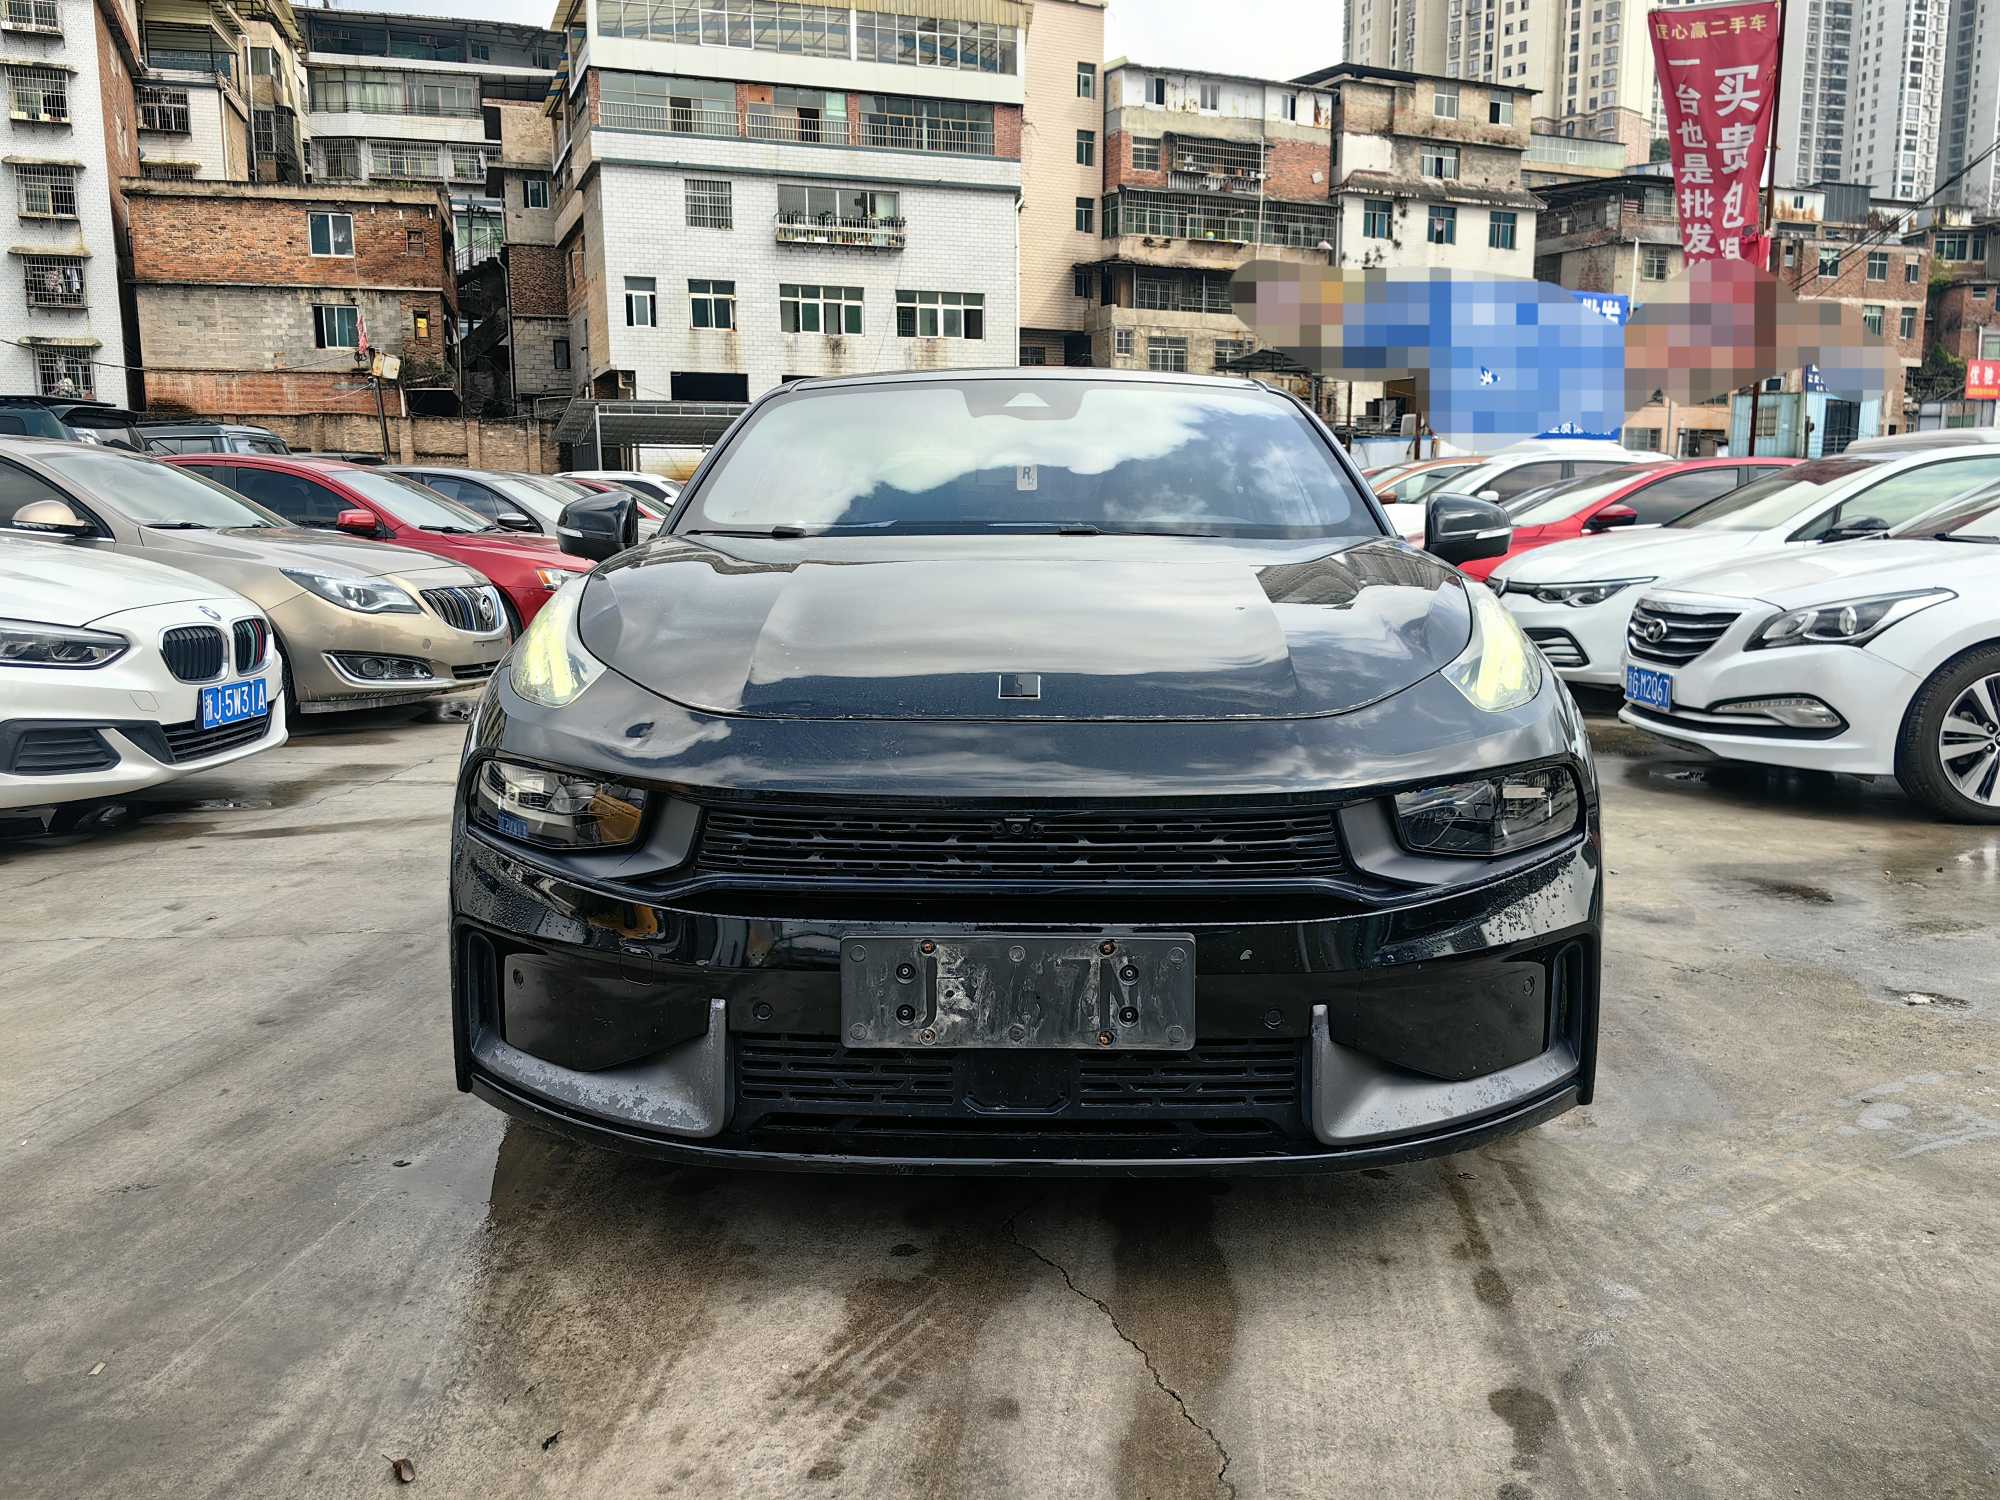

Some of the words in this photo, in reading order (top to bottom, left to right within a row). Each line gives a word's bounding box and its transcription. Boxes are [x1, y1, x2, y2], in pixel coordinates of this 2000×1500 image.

[1668, 58, 1715, 268] 一台也是批发
